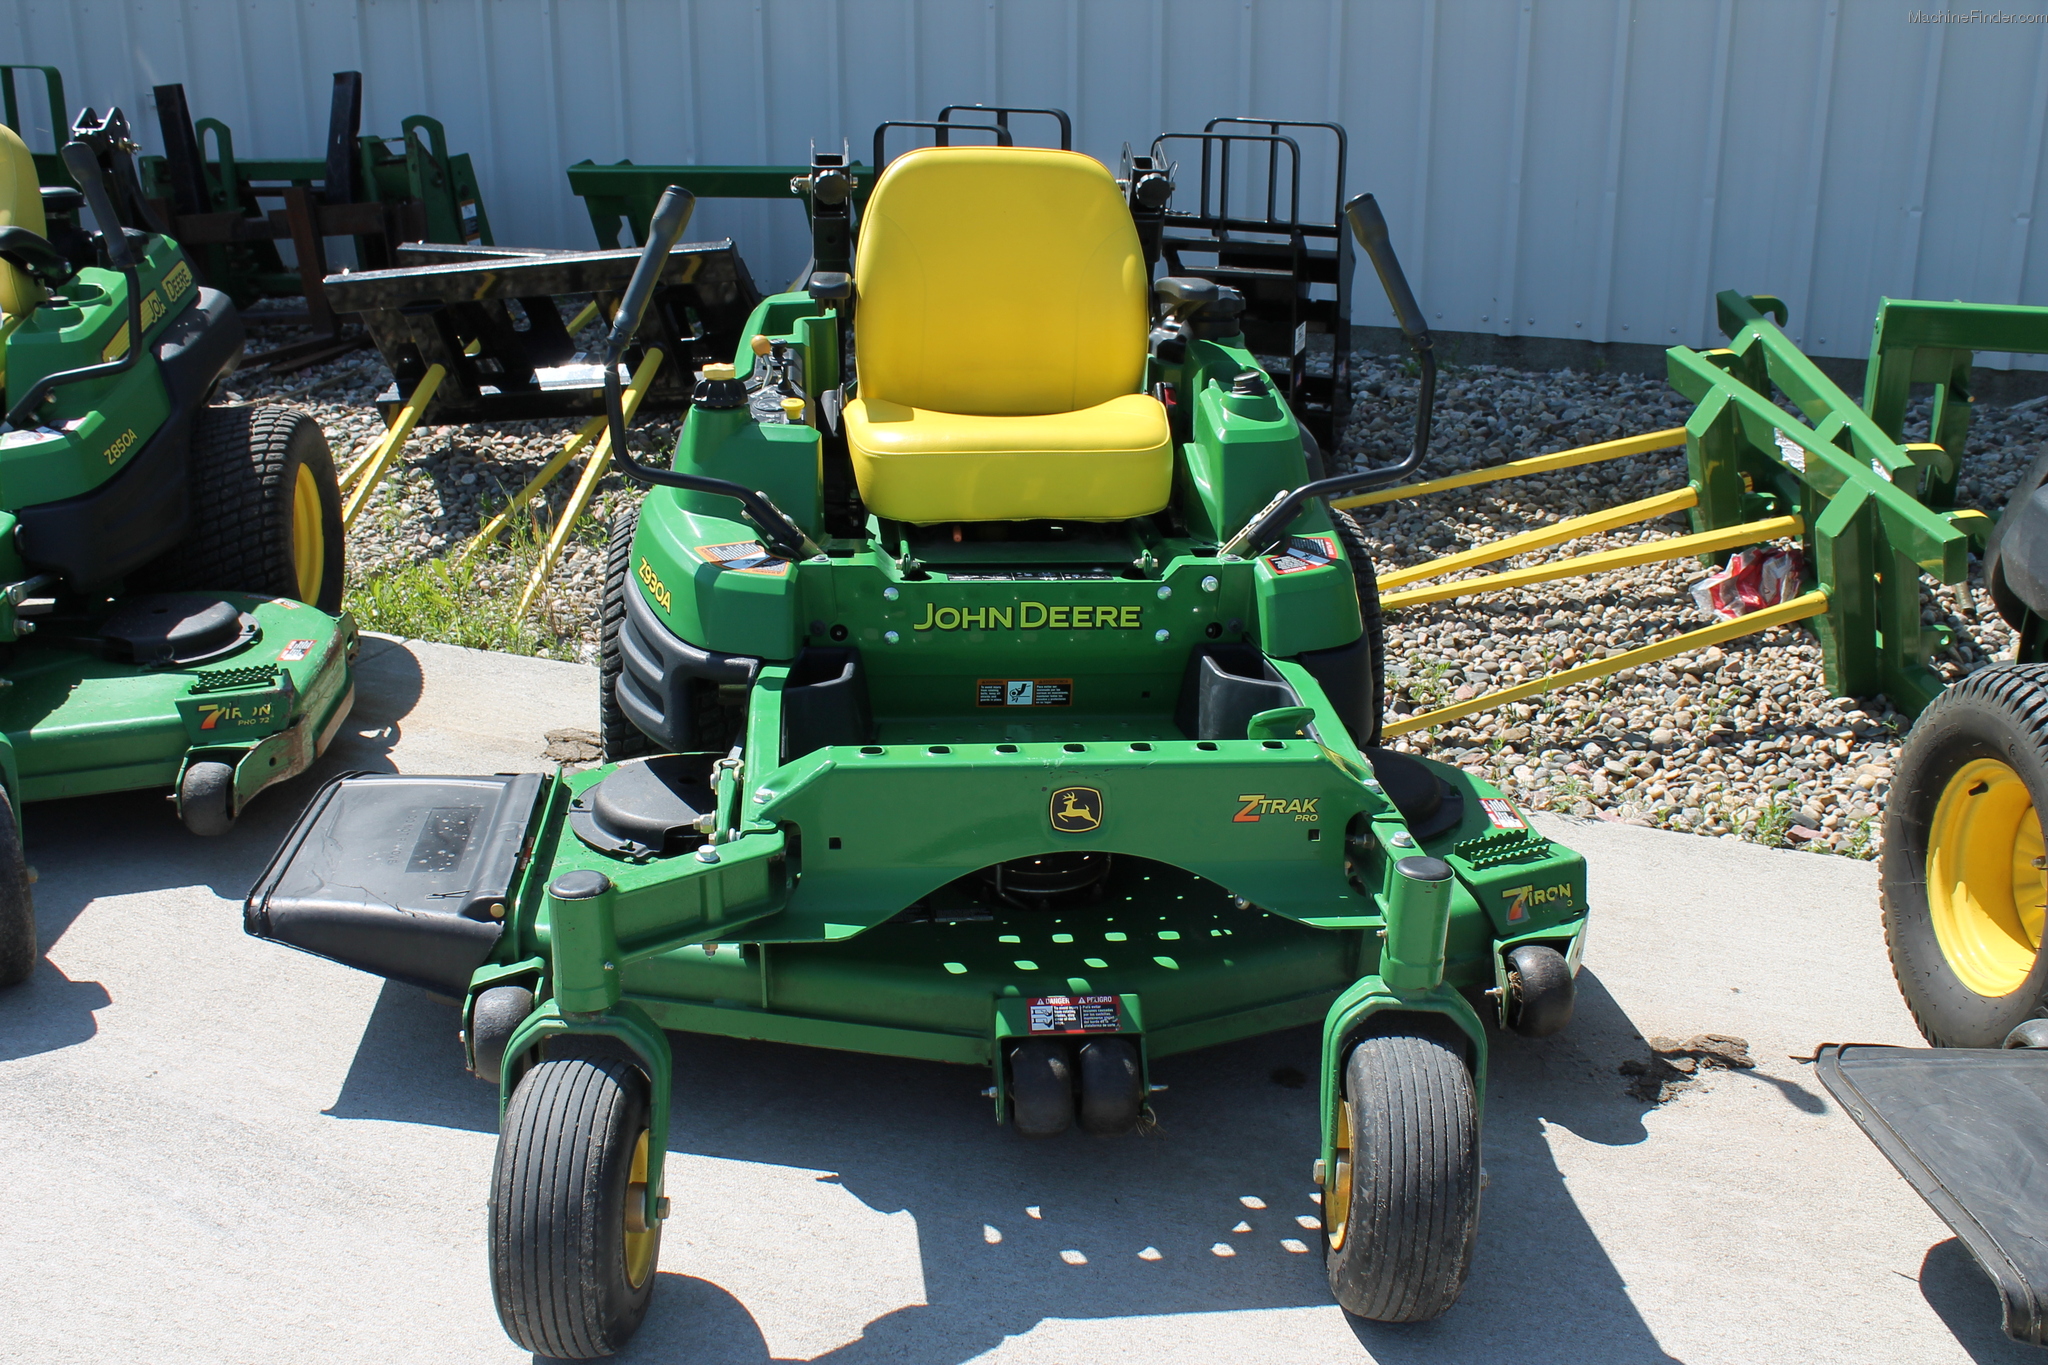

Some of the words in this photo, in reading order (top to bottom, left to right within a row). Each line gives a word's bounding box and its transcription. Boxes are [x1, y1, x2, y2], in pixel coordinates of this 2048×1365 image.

[165, 268, 191, 302] DEERE
[103, 428, 138, 465] Z850A
[638, 555, 672, 616] Z930A
[913, 602, 1013, 631] JOHN
[1019, 601, 1142, 631] DEERE
[238, 718, 257, 726] PRO
[1294, 814, 1319, 822] PRO
[1045, 997, 1071, 1005] DANGER
